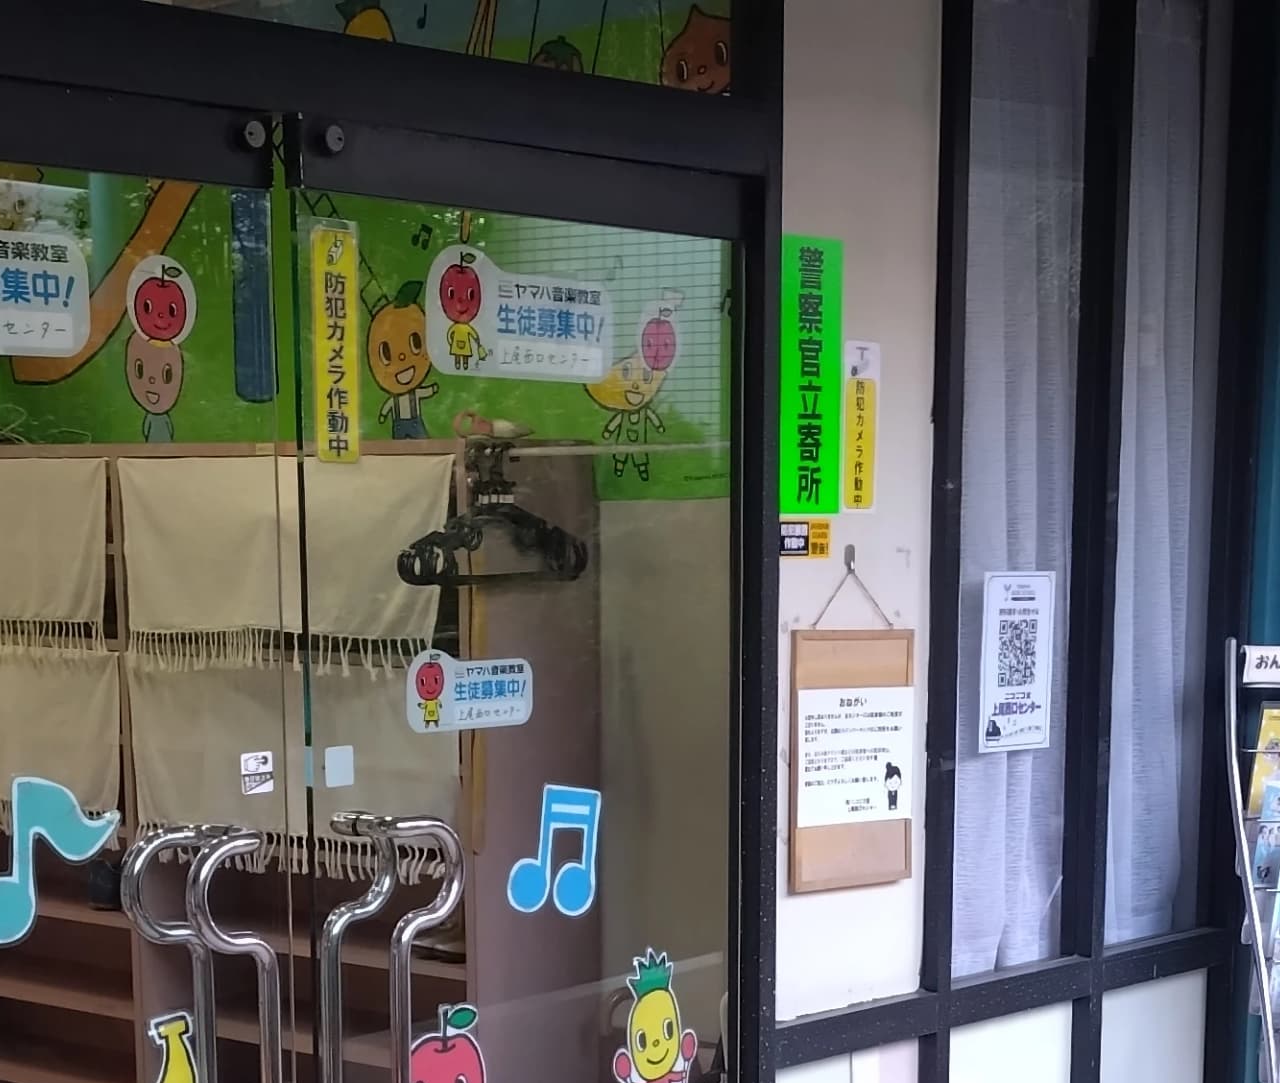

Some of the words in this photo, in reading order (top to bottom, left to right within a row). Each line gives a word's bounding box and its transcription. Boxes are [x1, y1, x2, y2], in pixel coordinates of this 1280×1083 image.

[515, 283, 601, 306] ヤマハ音楽教室
[497, 303, 606, 343] 生徒募集中!
[324, 270, 350, 458] 防犯カメラ作動中
[797, 245, 825, 506] 警察官立寄所
[454, 679, 526, 701] 生徒募集中!
